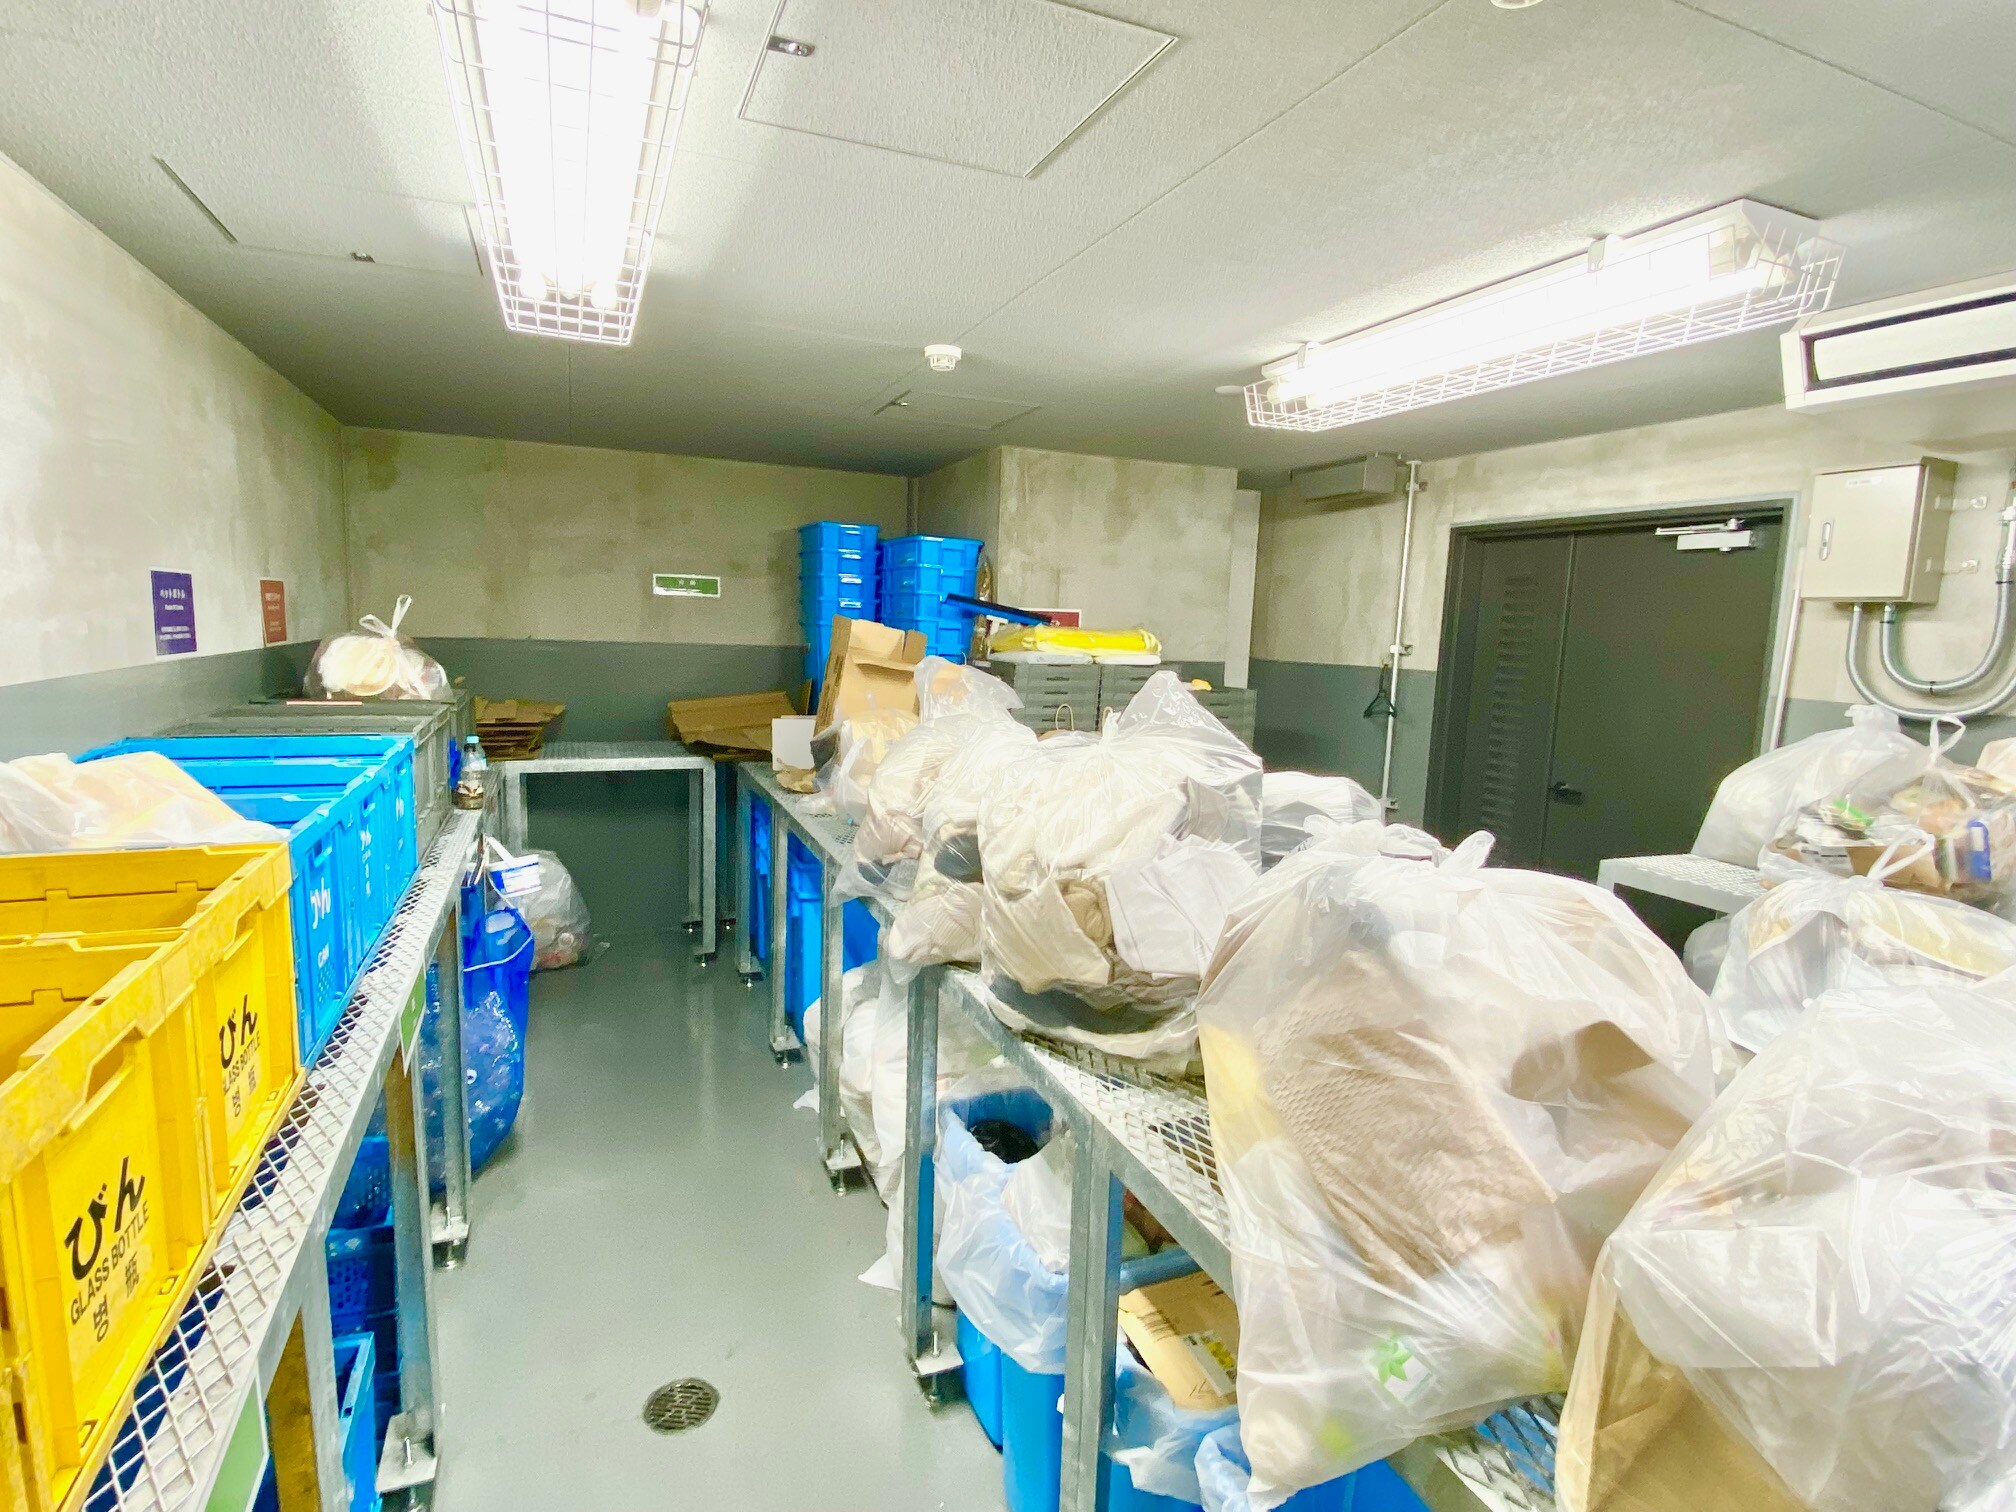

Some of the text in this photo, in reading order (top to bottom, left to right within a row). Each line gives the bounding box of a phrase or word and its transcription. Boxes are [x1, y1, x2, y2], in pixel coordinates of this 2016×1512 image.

[219, 994, 258, 1070] びん
[222, 1060, 240, 1096] LASS
[64, 1156, 145, 1281] びん
[70, 1200, 150, 1325] GLASS BOTTLE
